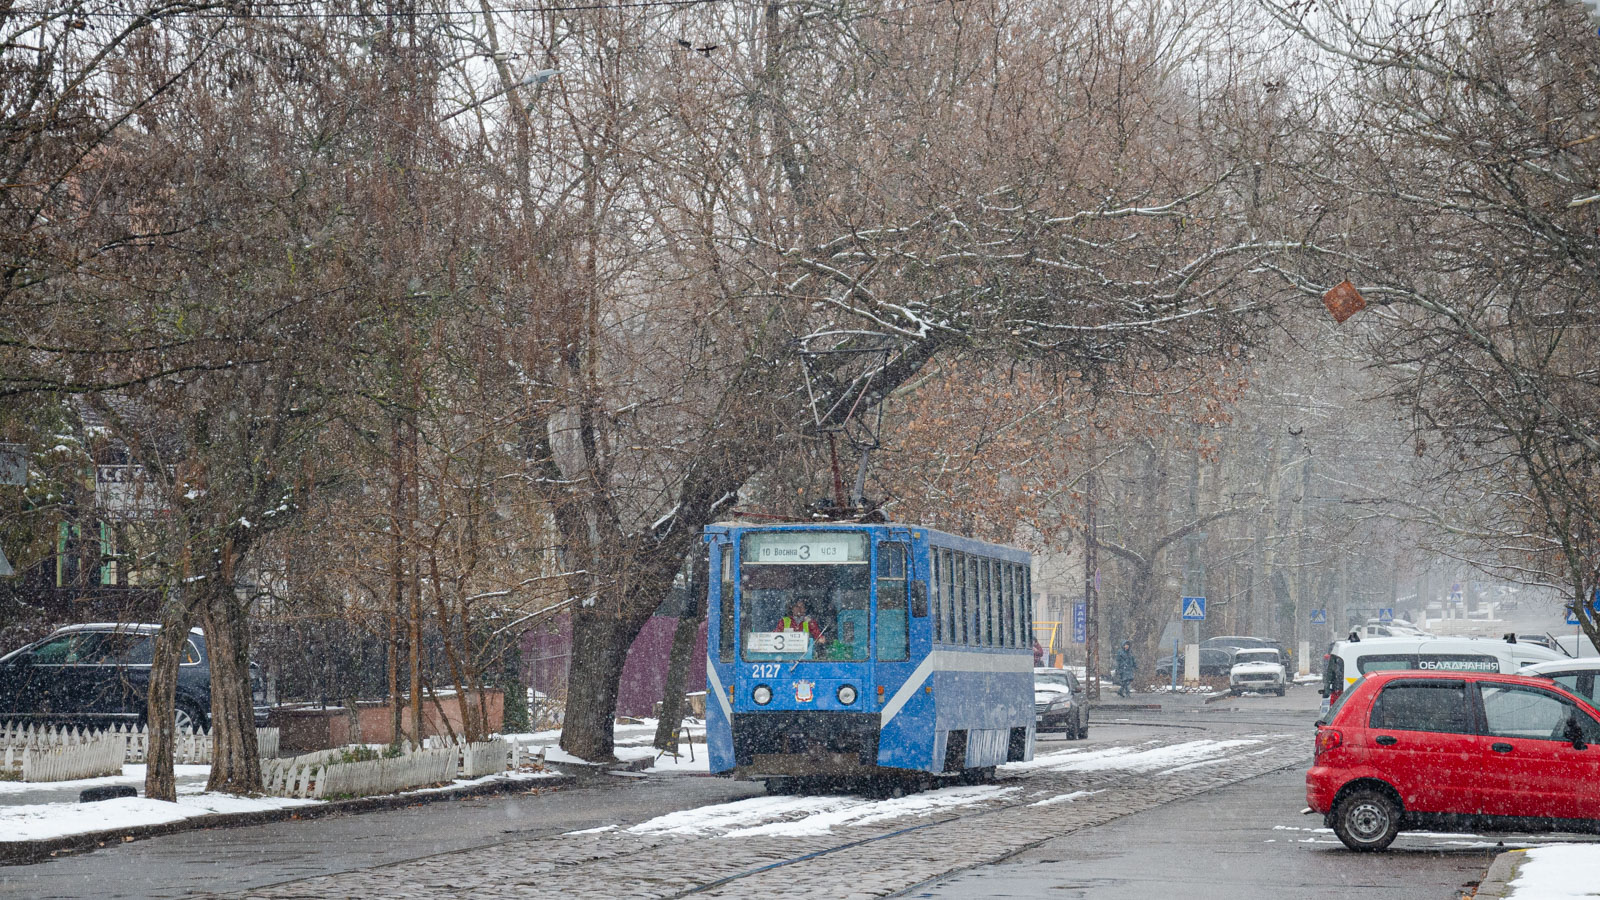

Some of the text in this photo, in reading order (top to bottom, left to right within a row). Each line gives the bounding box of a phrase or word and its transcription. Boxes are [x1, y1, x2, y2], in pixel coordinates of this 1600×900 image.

[762, 547, 771, 556] 10
[799, 545, 811, 560] 3
[773, 634, 786, 651] 3
[752, 663, 781, 679] 2127
[1419, 661, 1499, 671] ОБЛАДНАННЯ
